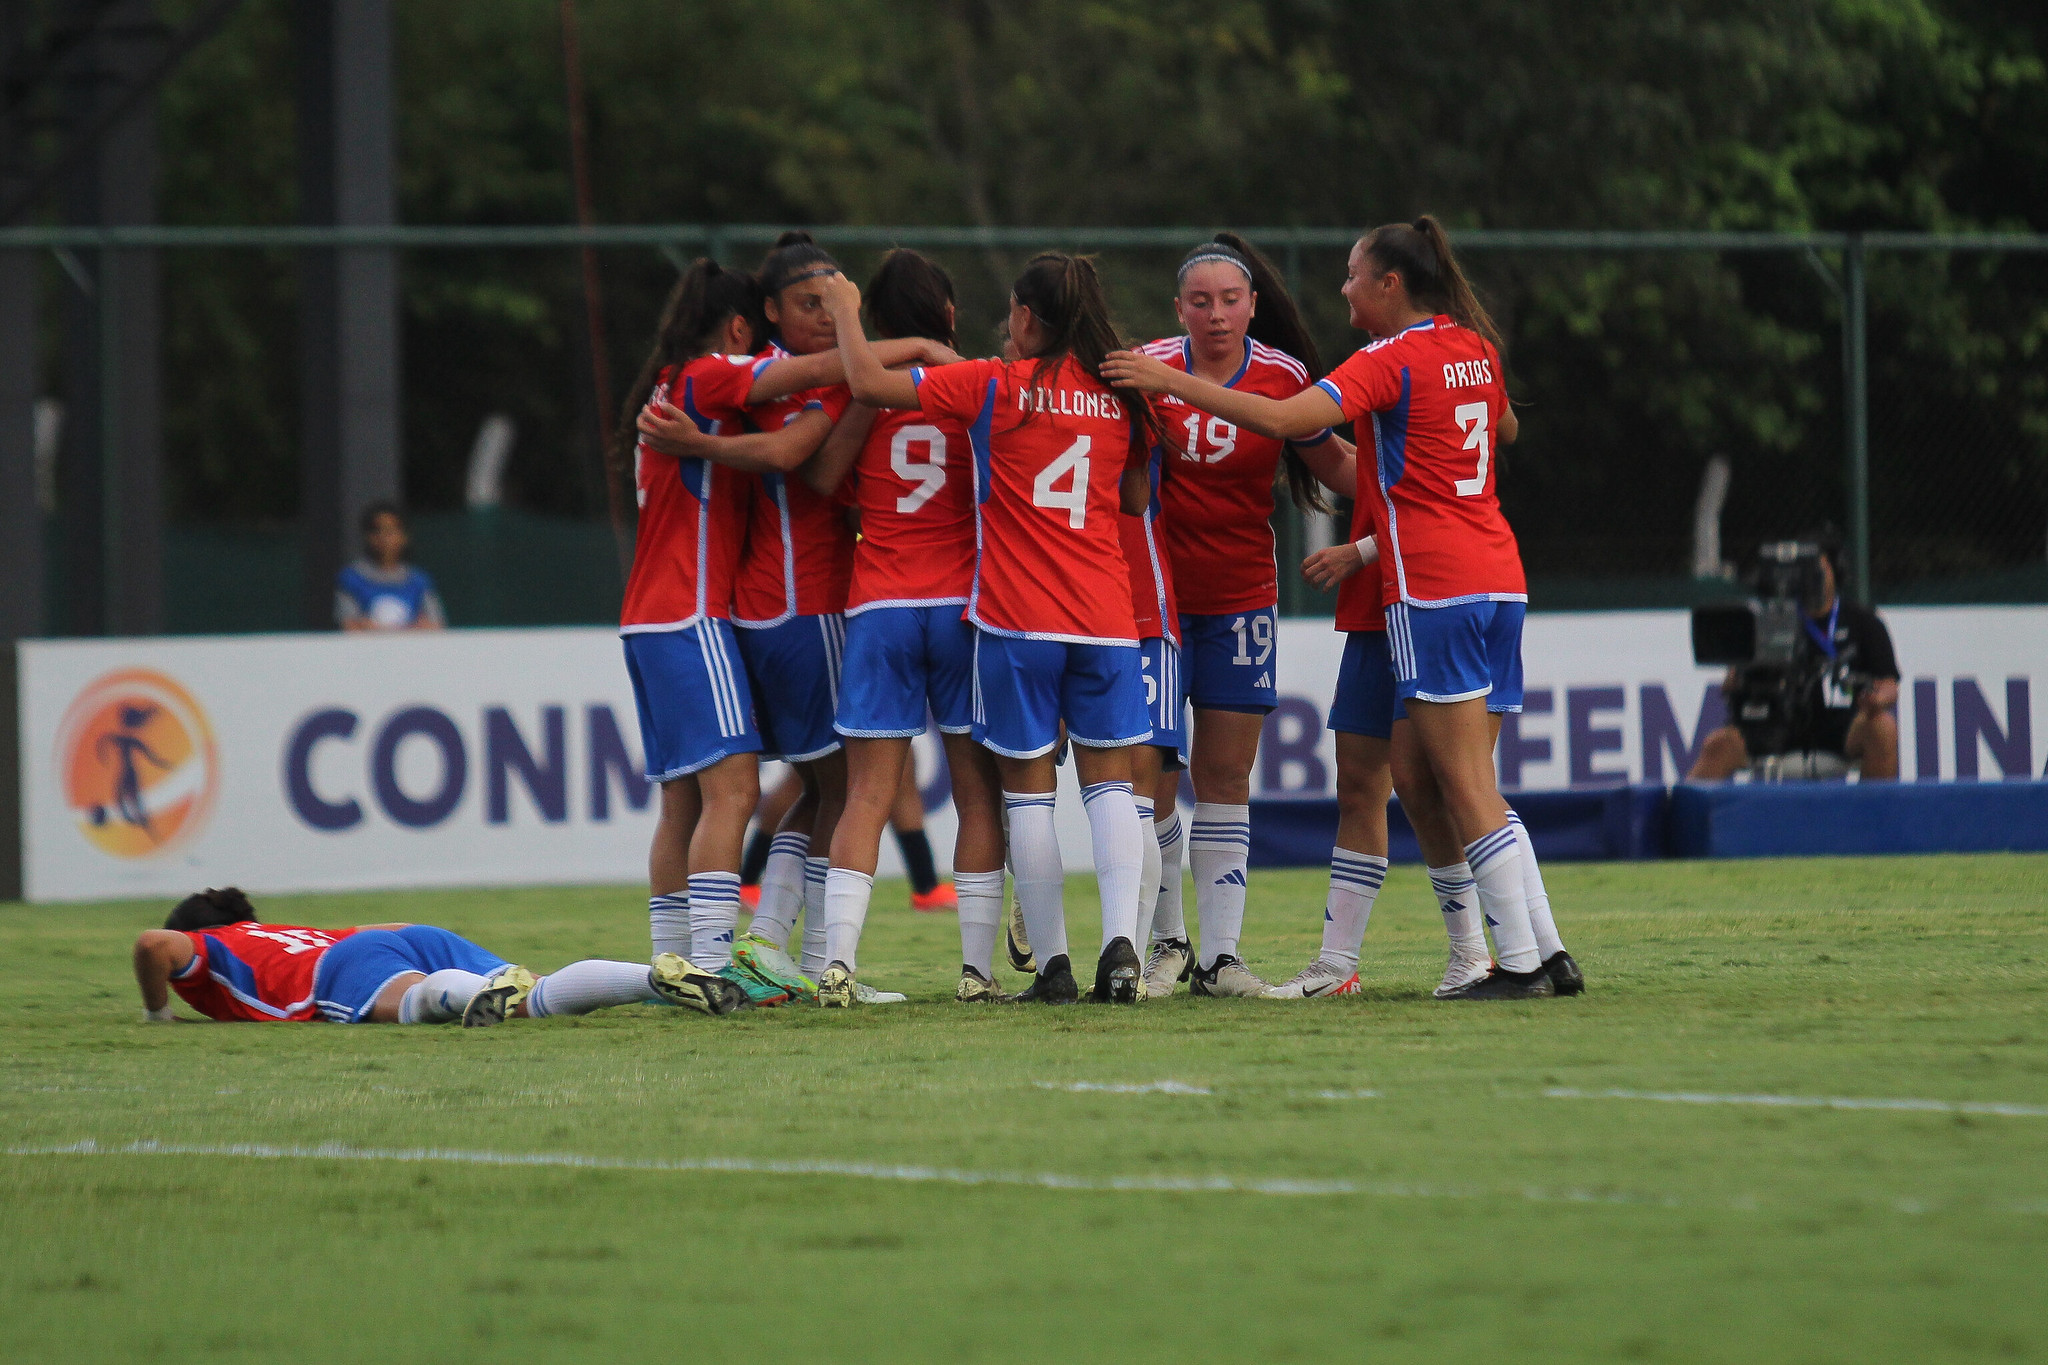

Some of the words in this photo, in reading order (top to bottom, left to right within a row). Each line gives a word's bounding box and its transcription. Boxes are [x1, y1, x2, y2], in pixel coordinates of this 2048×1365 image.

[1018, 385, 1121, 419] MILLONES
[1443, 358, 1492, 389] ARIAS
[890, 425, 946, 513] 9
[1181, 413, 1237, 463] 19
[1454, 401, 1489, 497] 3
[1033, 435, 1091, 529] 4
[1231, 616, 1273, 665] 19
[284, 705, 653, 831] CONM
